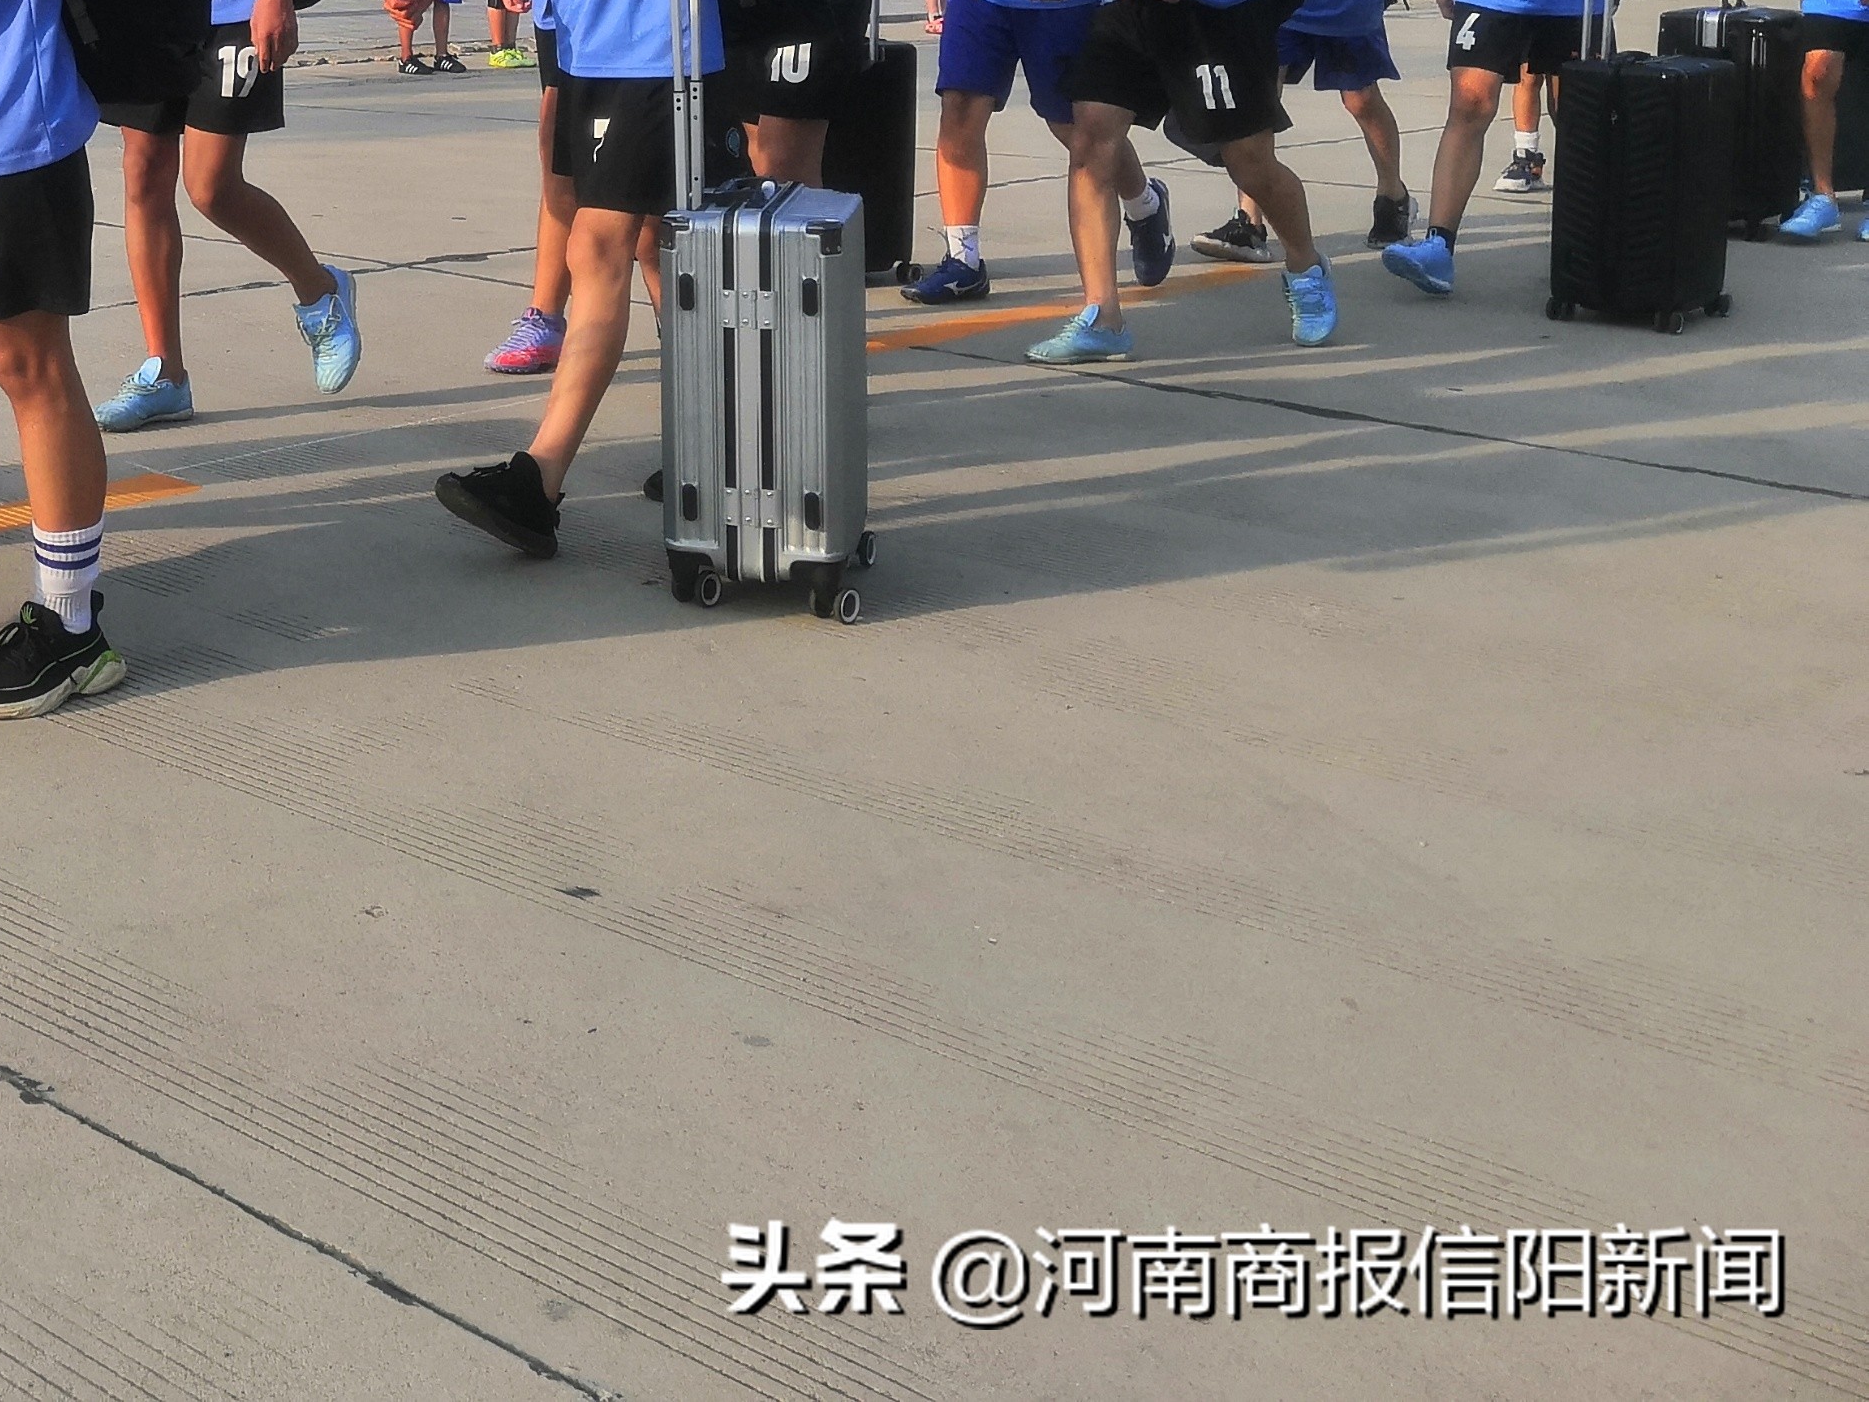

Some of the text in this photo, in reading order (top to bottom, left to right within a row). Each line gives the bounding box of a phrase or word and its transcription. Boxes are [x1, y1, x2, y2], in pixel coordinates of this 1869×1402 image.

[1455, 12, 1481, 50] 4
[218, 45, 259, 98] 19
[1195, 64, 1236, 110] 11
